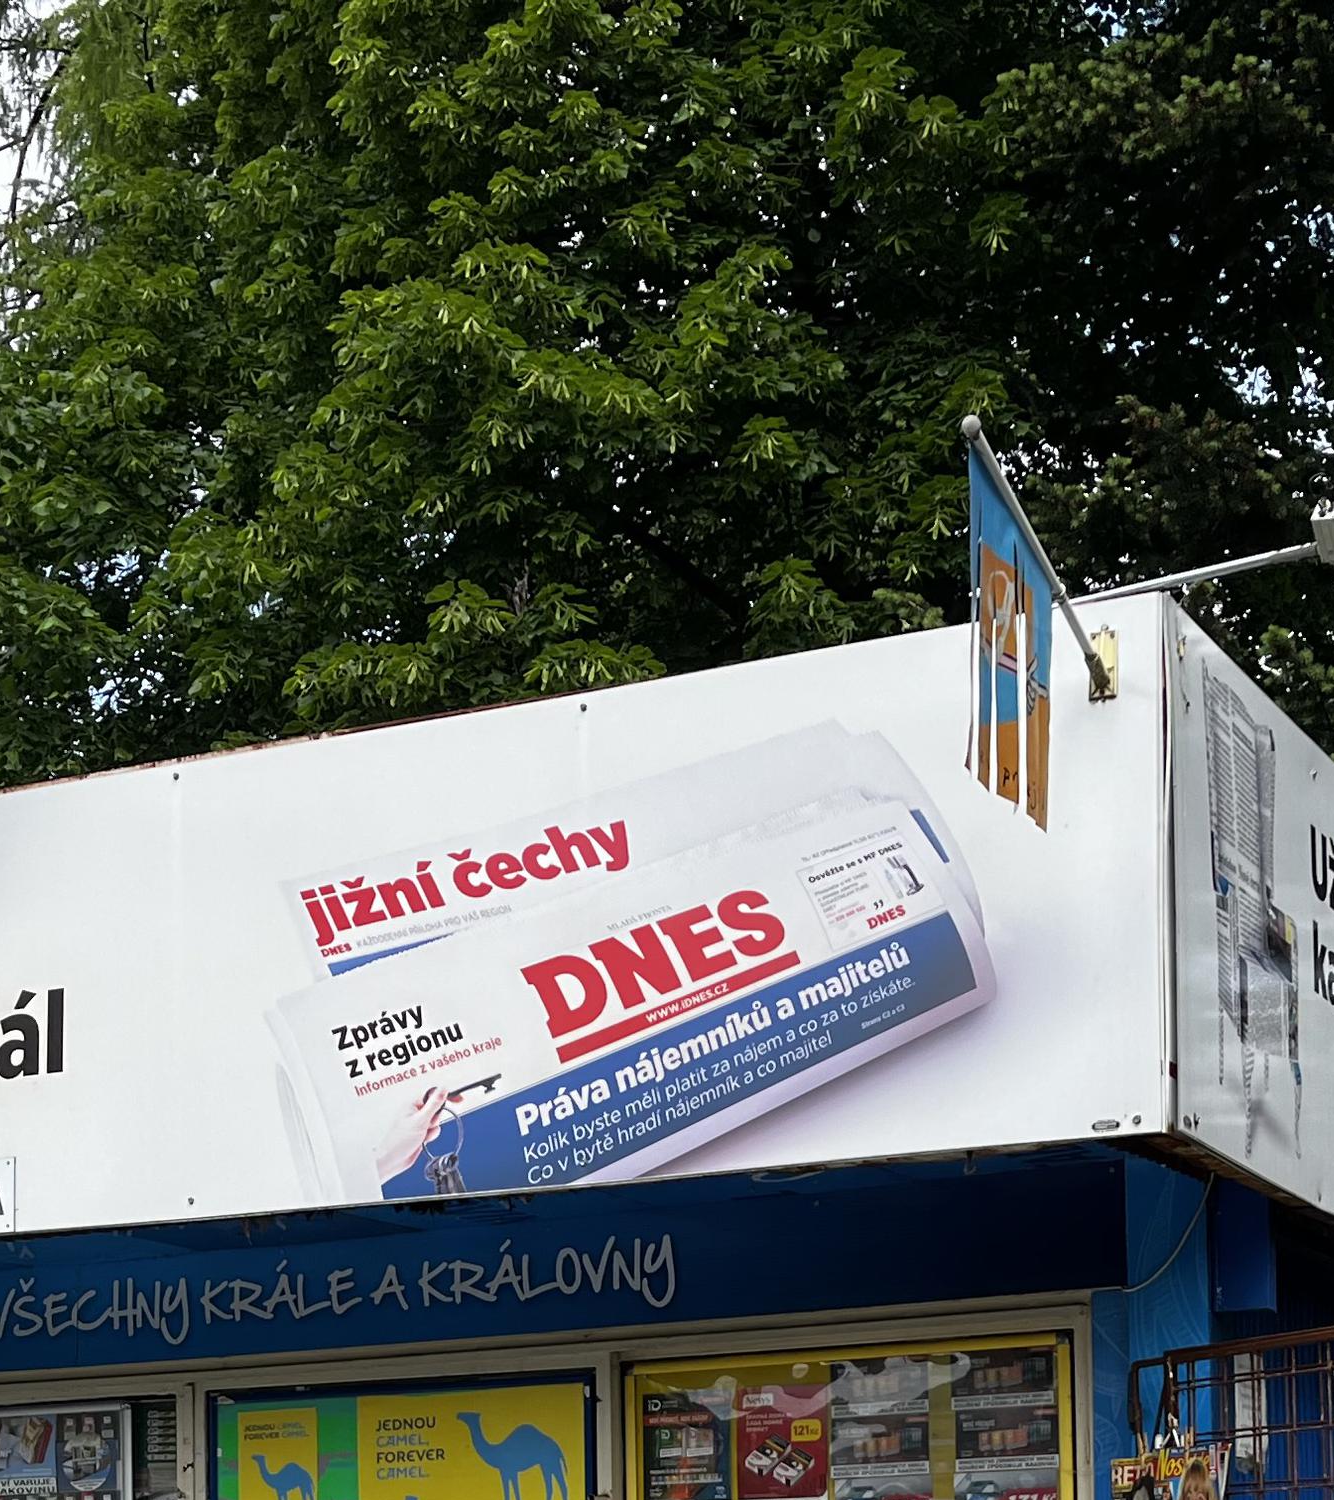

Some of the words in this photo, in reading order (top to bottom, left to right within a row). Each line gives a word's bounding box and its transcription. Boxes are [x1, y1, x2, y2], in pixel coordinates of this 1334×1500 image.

[300, 860, 445, 947] jižní
[447, 820, 630, 898] čechy
[846, 860, 856, 869] se
[878, 842, 903, 856] DNES
[867, 905, 906, 930] DNES
[321, 942, 352, 957] DNES
[521, 889, 787, 1039] DNES
[332, 1005, 422, 1051] Zprávy
[345, 1059, 363, 1079] z
[369, 1022, 463, 1073] regionu
[515, 1075, 611, 1137] Práva
[615, 1000, 771, 1094] nájemníků
[776, 997, 795, 1020] a
[797, 941, 910, 1012] majitelů
[355, 1069, 417, 1098] Informace
[419, 1062, 428, 1074] z
[430, 1048, 471, 1070] vašeho
[472, 1037, 502, 1058] kraje
[524, 1130, 569, 1164] Kolik
[572, 1108, 621, 1143] byste
[625, 1085, 662, 1118] měli
[665, 1067, 708, 1104] platit
[712, 1060, 730, 1078] za
[733, 1032, 783, 1075] nájem
[785, 1027, 796, 1043] a
[797, 1017, 817, 1037] co
[821, 1010, 839, 1030] za
[841, 1000, 858, 1019] to
[860, 977, 916, 1012] získáte.
[528, 1163, 553, 1185] Co
[557, 1156, 568, 1171] v
[573, 1134, 614, 1167] bytě
[617, 1114, 662, 1145] hradí
[665, 1075, 741, 1124] nájemník
[744, 1069, 754, 1084] a
[756, 1059, 776, 1079] co
[779, 1032, 832, 1074] majitel
[200, 1259, 362, 1324] KRÁLE
[370, 1264, 409, 1310] A
[419, 1234, 676, 1309] KRÁLOVNY
[376, 1416, 436, 1433] JEDNOU
[793, 1425, 809, 1436] 121
[376, 1448, 445, 1464] FOREVER
